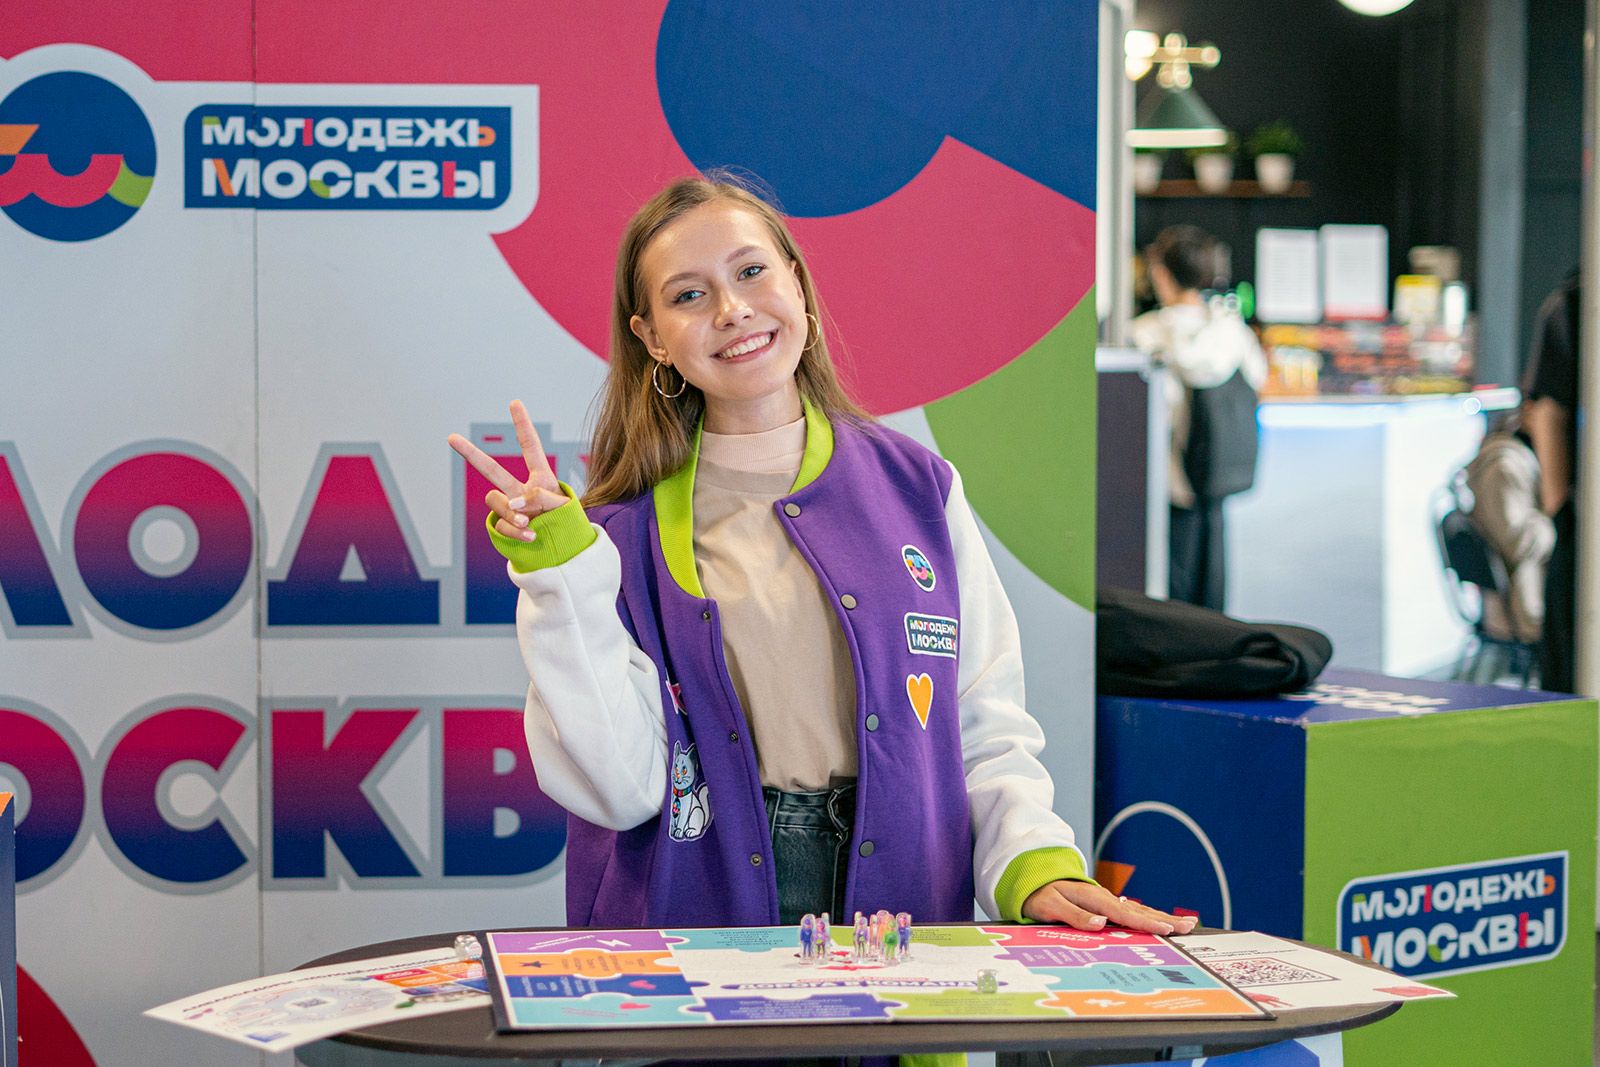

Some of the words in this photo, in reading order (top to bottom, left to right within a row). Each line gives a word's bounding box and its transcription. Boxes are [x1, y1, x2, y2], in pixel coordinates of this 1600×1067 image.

[202, 116, 496, 152] МОЛОДЕЖЬ
[202, 158, 496, 199] МОСКВЫ
[1352, 869, 1556, 923] МОЛОДЕЖЬ
[1352, 908, 1555, 969] МОСКВЫ
[866, 979, 978, 988] КОМАНД
